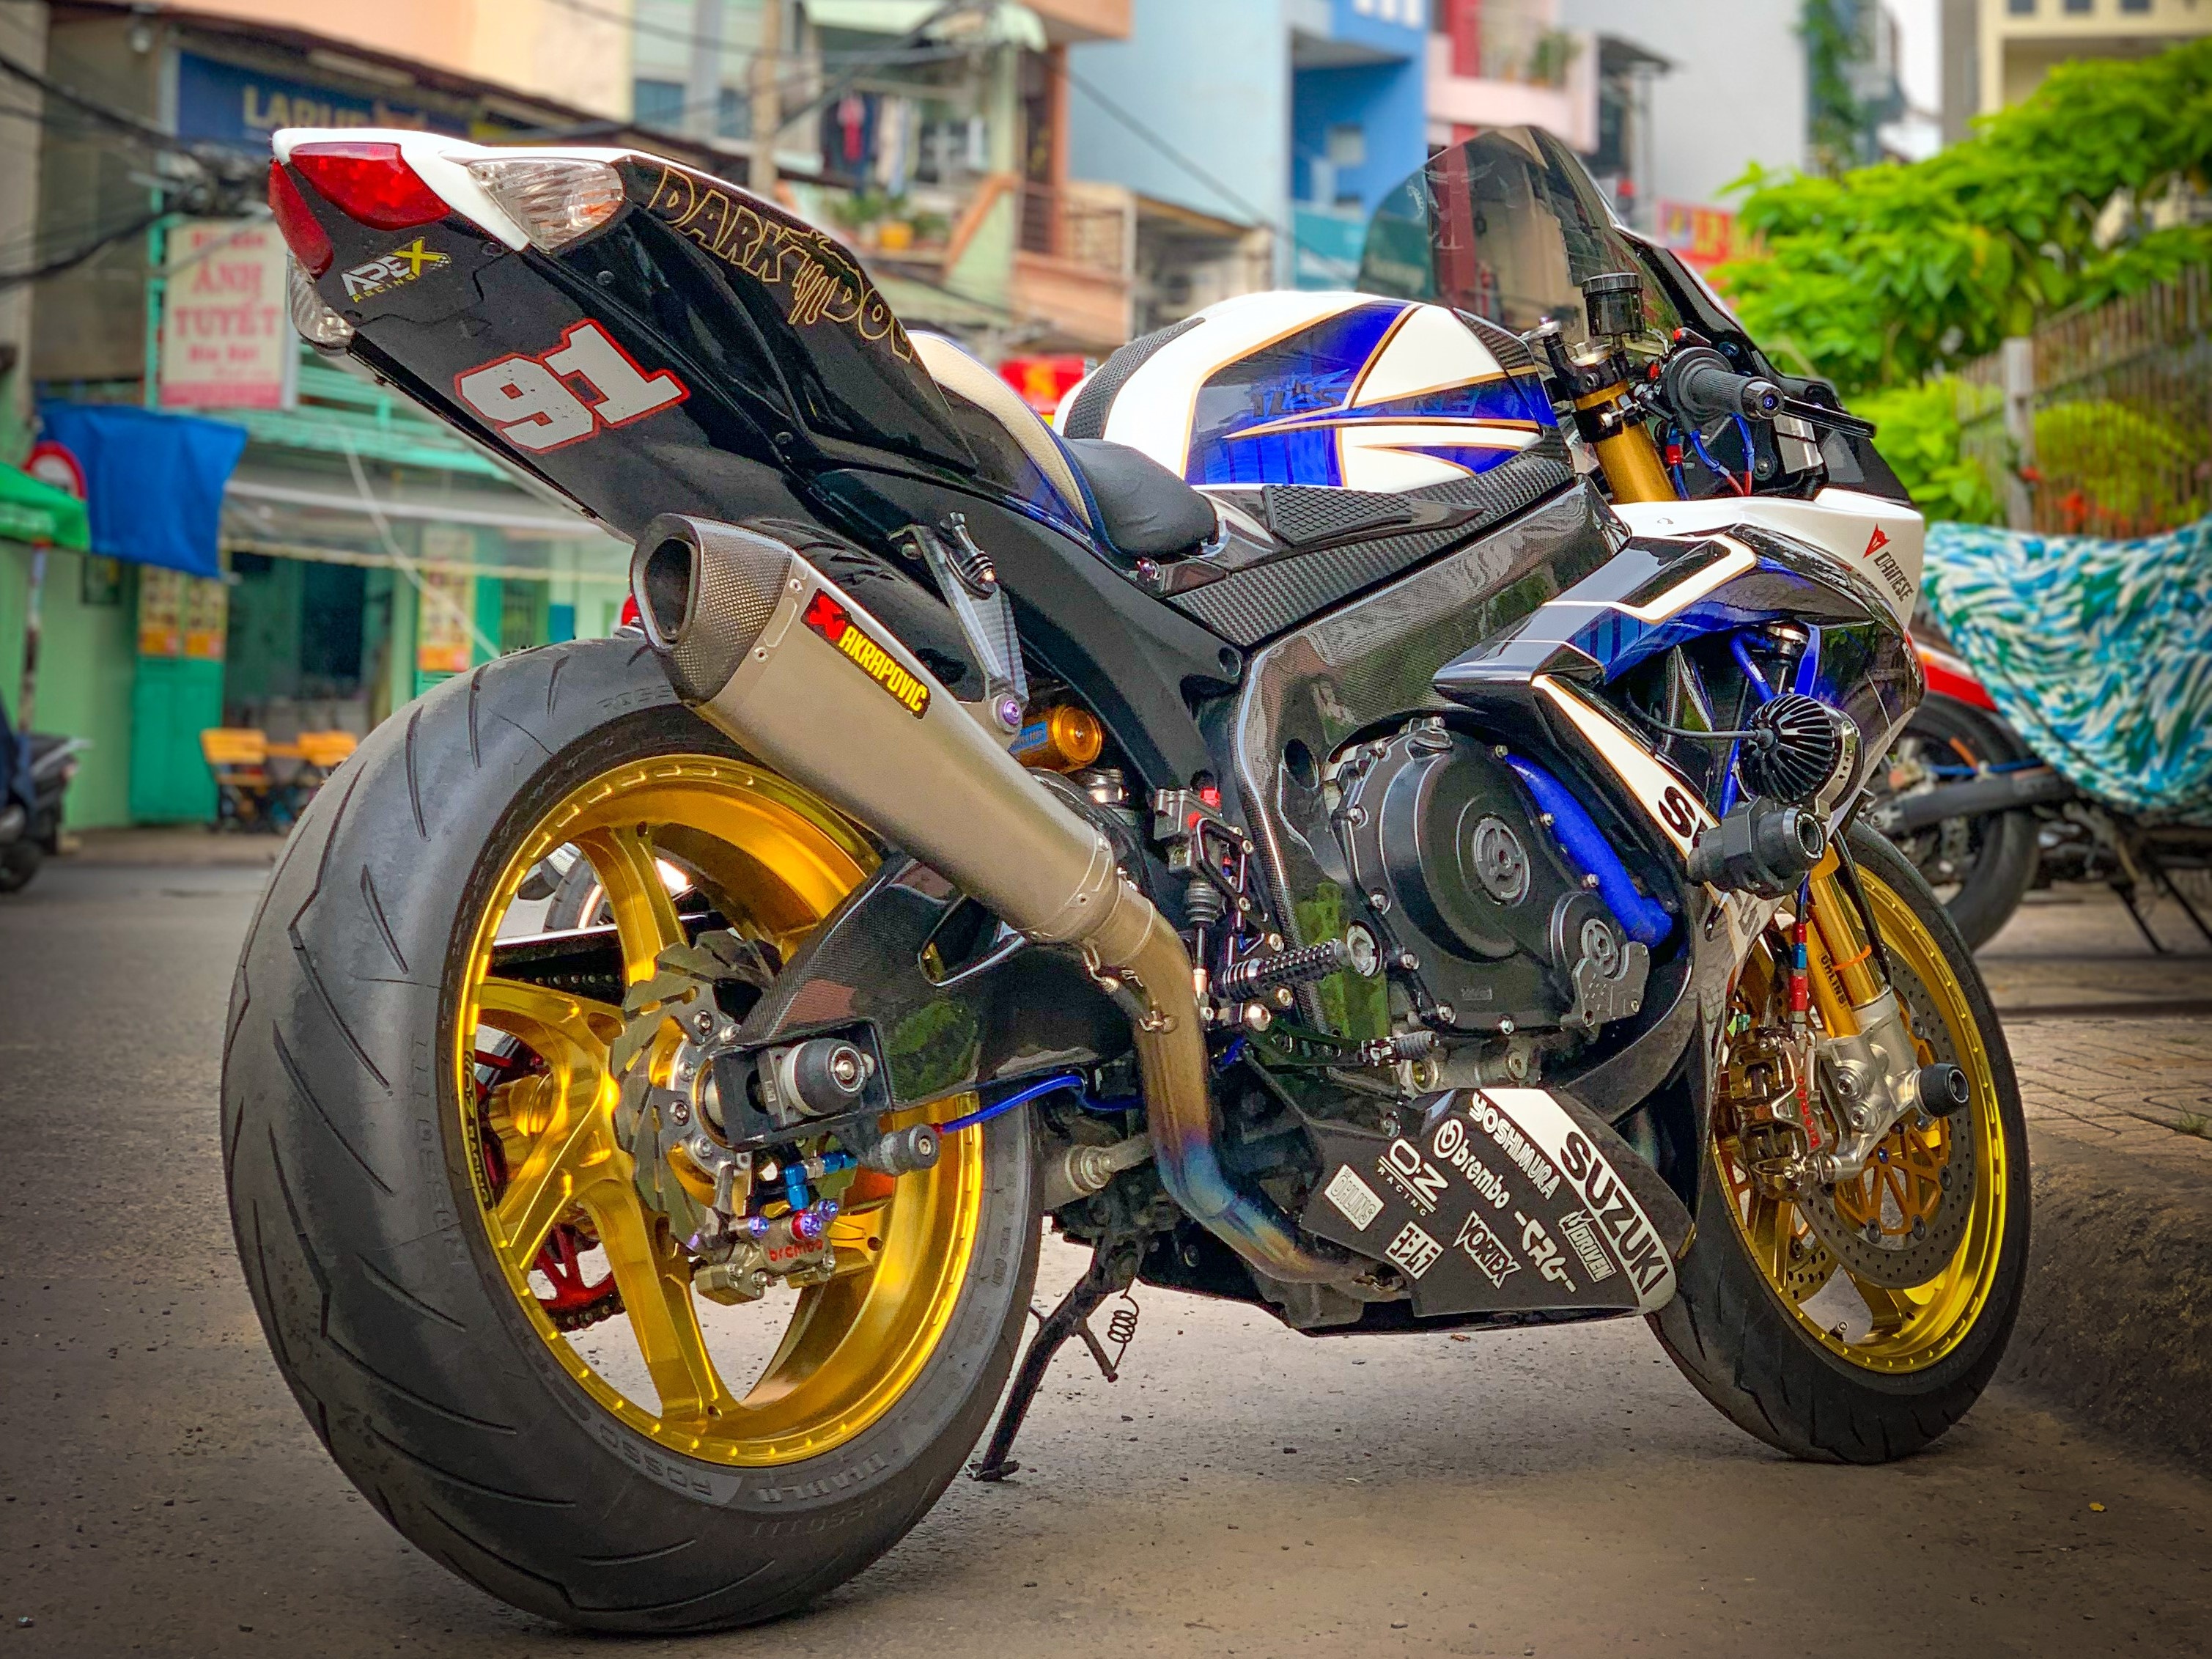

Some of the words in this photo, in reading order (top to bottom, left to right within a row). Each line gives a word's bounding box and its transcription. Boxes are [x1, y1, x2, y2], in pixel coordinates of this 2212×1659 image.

[648, 165, 800, 283] DARK
[340, 237, 444, 298] APEX
[352, 273, 416, 304] RACING
[454, 317, 690, 455] 91
[1451, 1138, 1511, 1210] brembo
[1469, 1092, 1561, 1201] YOSHIMURA
[1376, 1166, 1428, 1218] RACING
[1560, 1130, 1670, 1295] SUZUKI
[1459, 1213, 1519, 1286] VORTEX
[1570, 1226, 1615, 1280] DRIVEN
